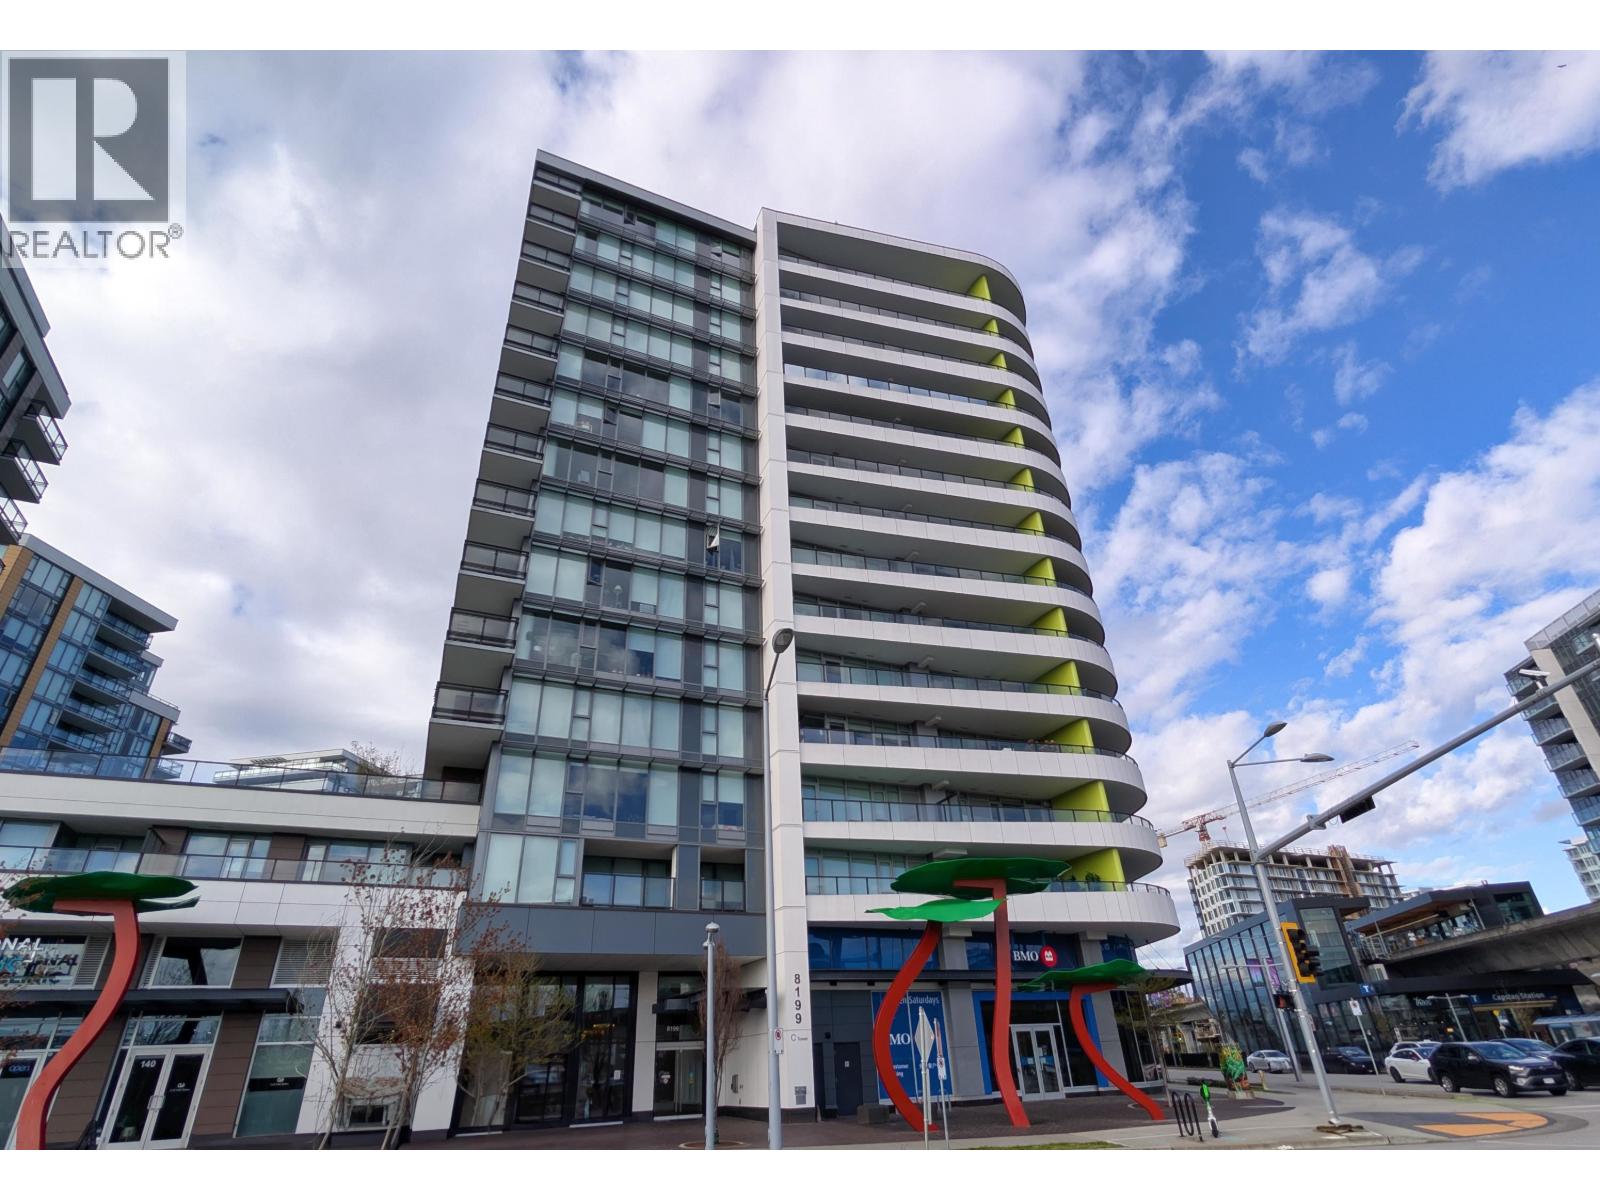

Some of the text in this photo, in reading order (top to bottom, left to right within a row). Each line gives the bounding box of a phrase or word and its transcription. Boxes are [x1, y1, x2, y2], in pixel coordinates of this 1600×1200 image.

[0, 937, 44, 951] NAL
[1013, 950, 1039, 961] BMO
[794, 973, 802, 1025] 8199
[909, 994, 940, 1006] Saturdays
[1519, 992, 1545, 1000] Station
[889, 1032, 911, 1046] MO
[140, 1059, 157, 1068] 140
